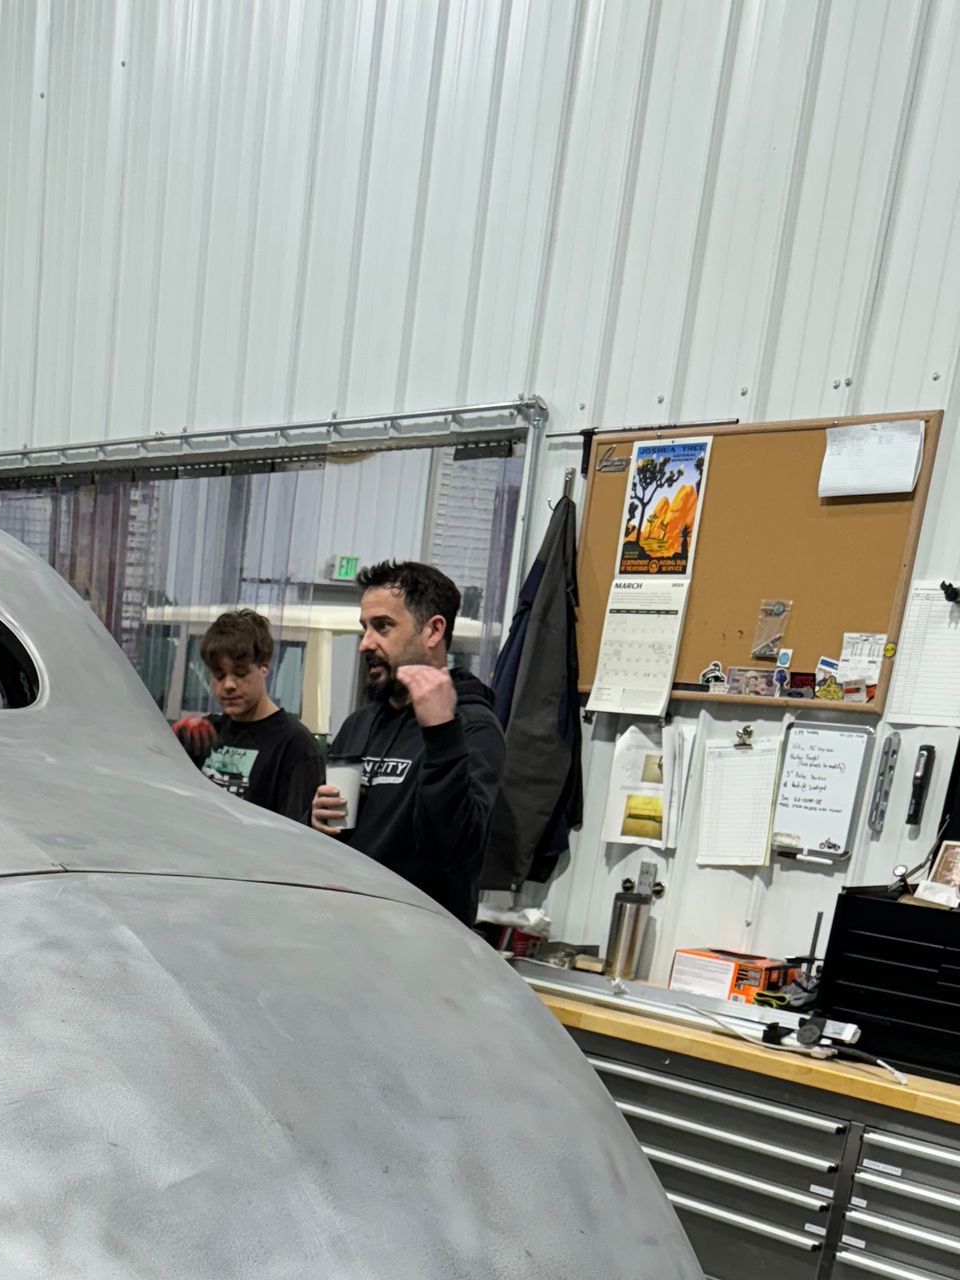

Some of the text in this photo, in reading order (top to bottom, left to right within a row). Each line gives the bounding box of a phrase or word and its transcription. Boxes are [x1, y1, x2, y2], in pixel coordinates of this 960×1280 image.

[640, 446, 676, 455] JOSHUA
[338, 557, 359, 577] EXIT
[614, 582, 642, 590] MARCH
